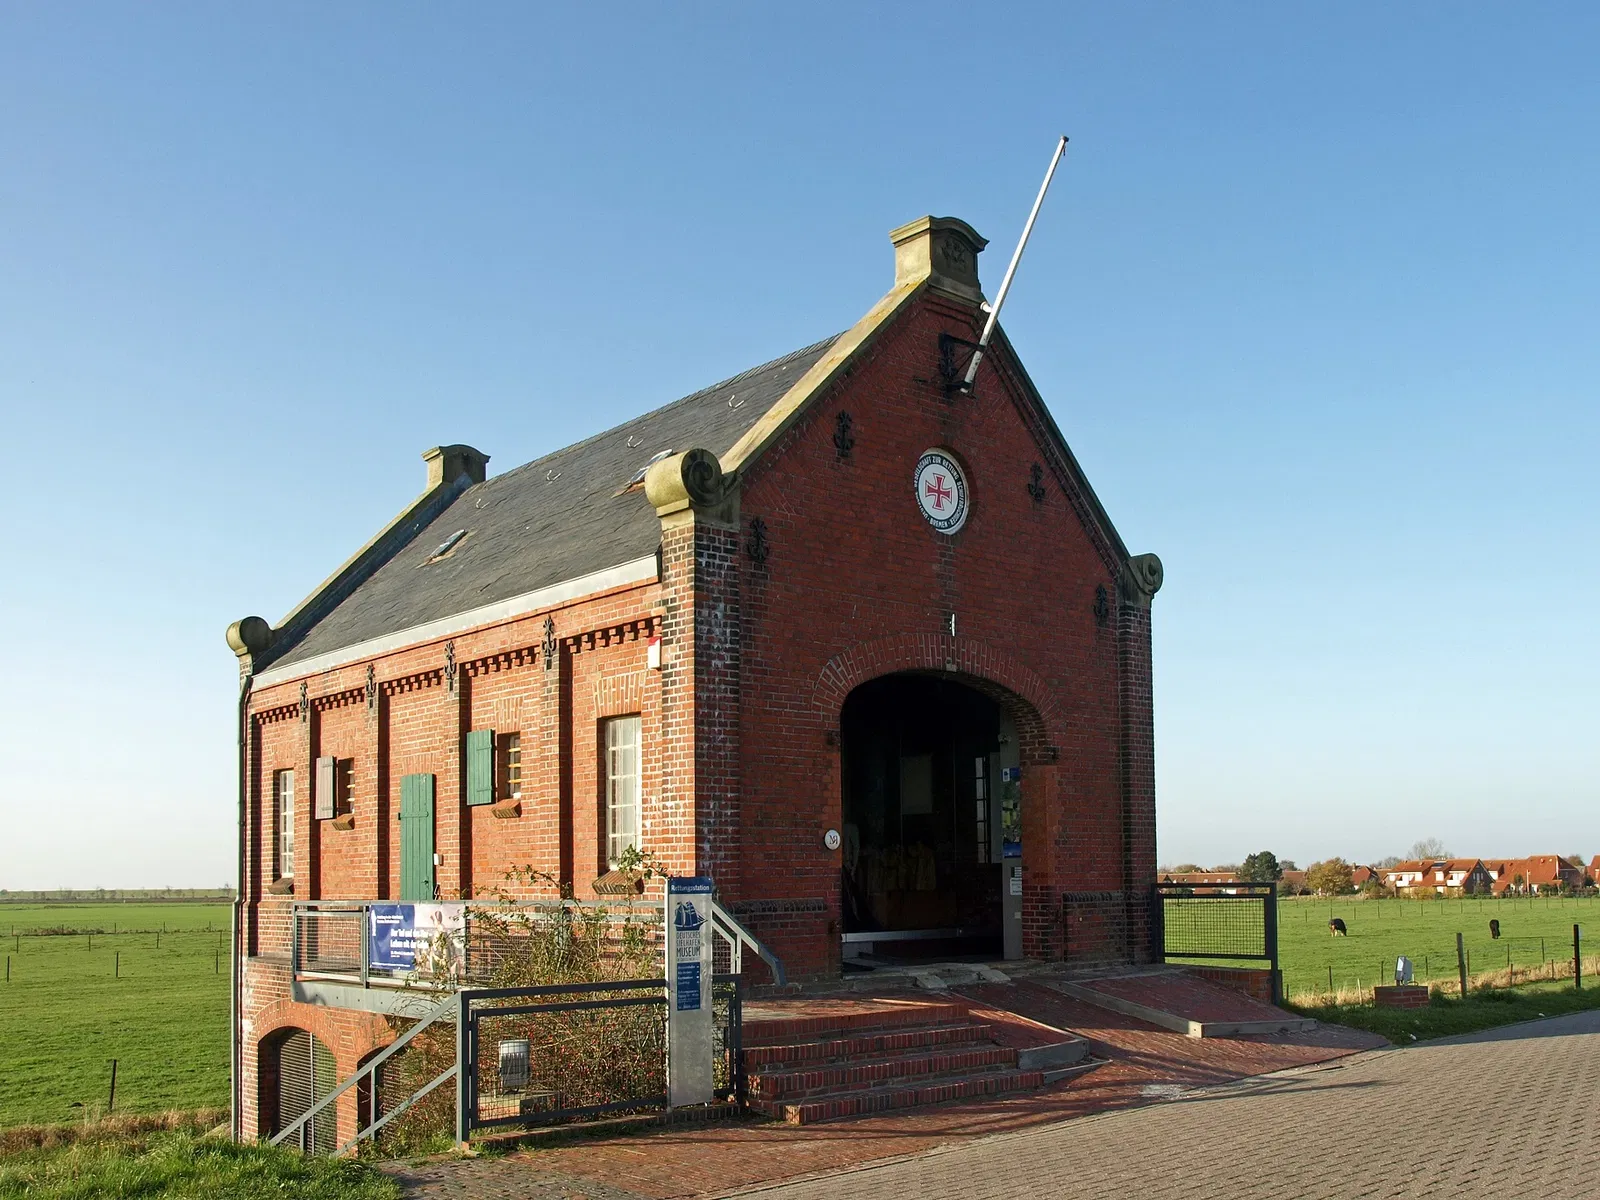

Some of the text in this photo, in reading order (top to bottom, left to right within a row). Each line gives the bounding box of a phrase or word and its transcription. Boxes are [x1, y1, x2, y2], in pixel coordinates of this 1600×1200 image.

[932, 456, 941, 464] ZUR
[942, 459, 959, 480] RETTUNG
[929, 518, 948, 528] BREMEN
[671, 884, 710, 892] Rettungsstation
[676, 931, 700, 939] DEUTSCHES
[676, 939, 700, 947] SIELHAFEN
[676, 946, 700, 958] MUSEUM
